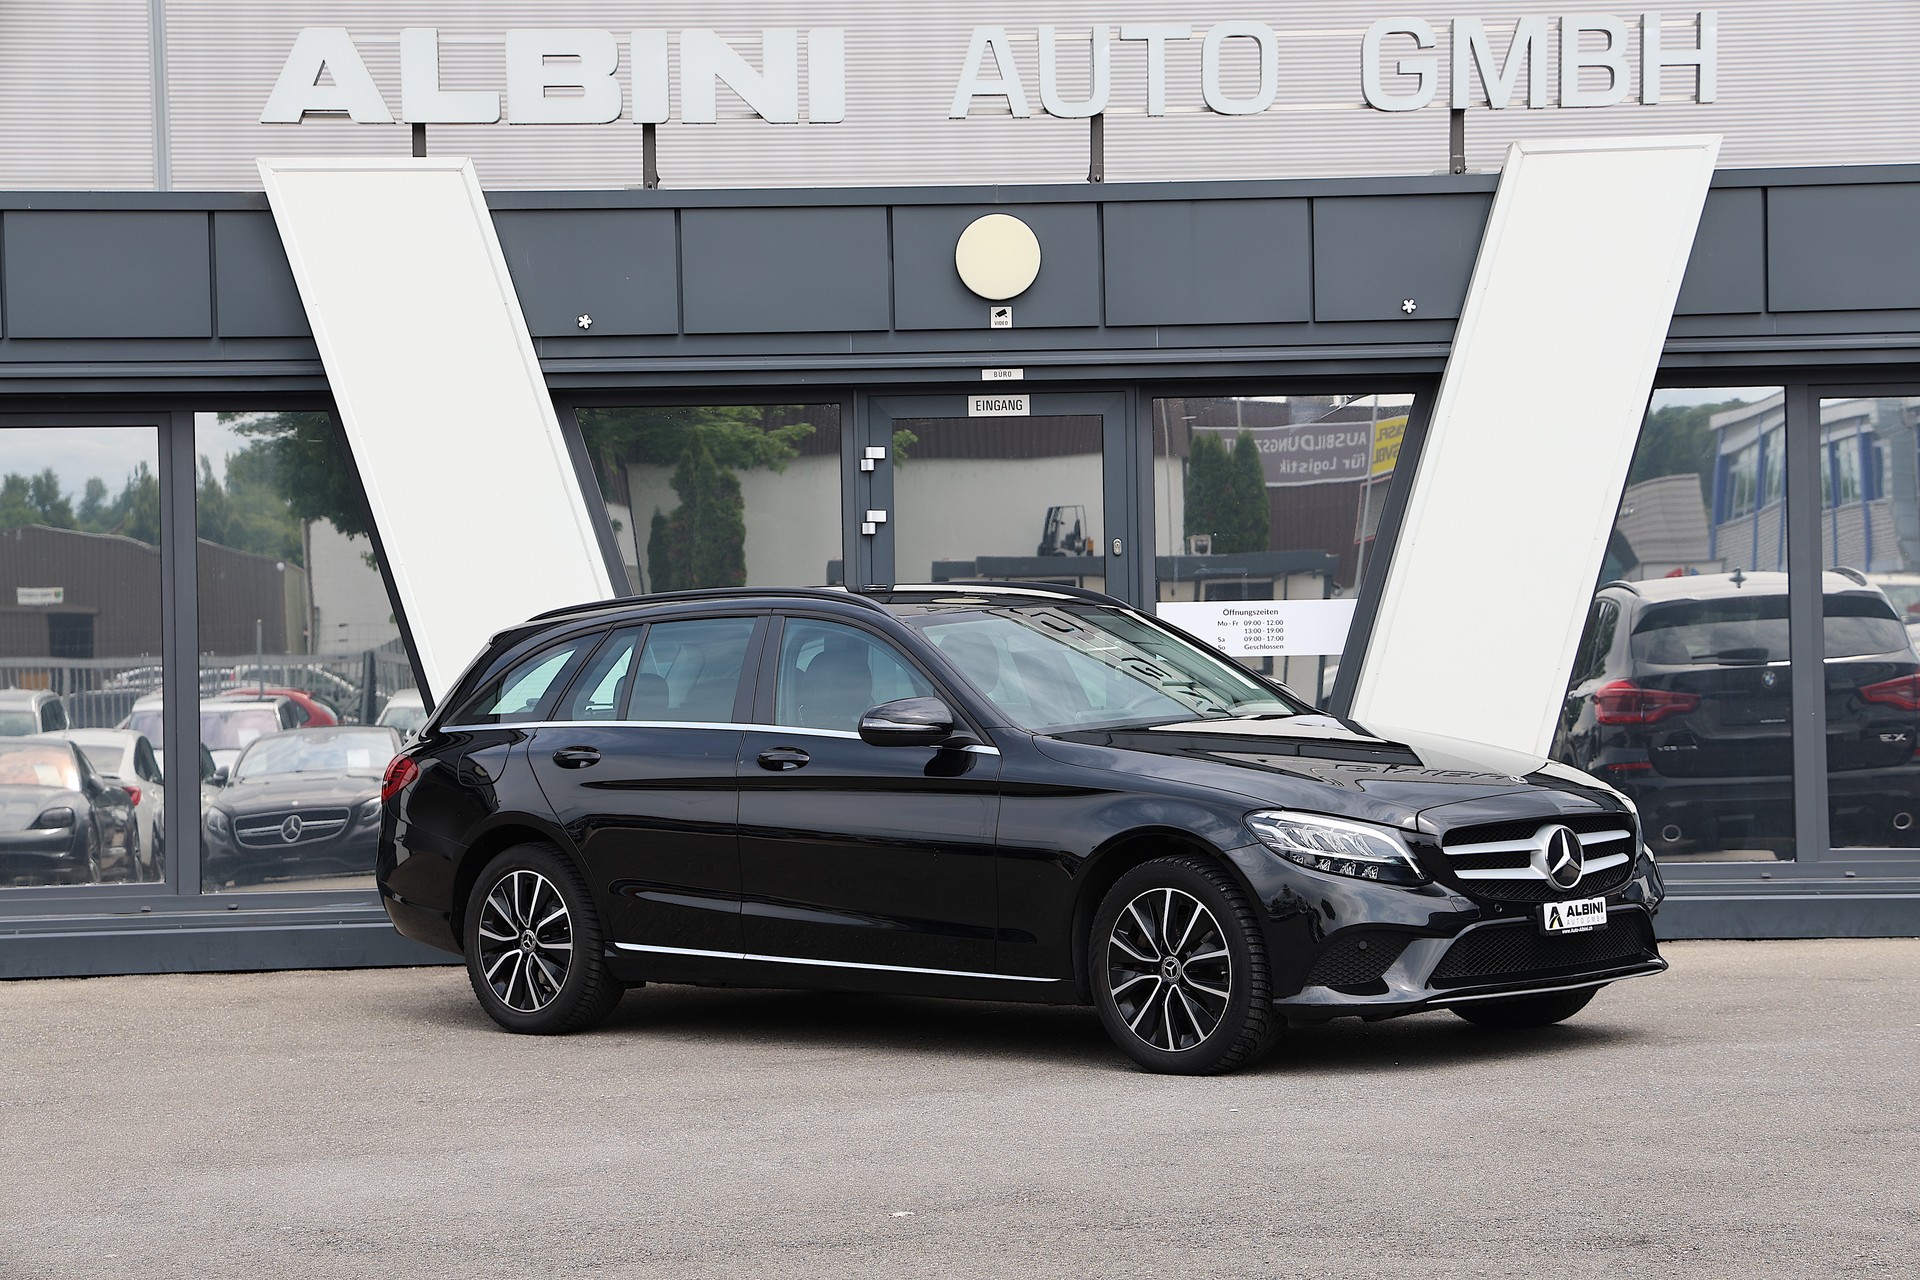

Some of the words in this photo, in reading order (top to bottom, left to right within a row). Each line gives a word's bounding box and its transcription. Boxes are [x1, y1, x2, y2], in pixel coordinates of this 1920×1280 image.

[259, 27, 845, 125] ALBINI
[948, 21, 1279, 120] AUTO
[1360, 10, 1719, 113] GMBH
[993, 369, 1012, 378] BÜRO
[975, 399, 1023, 412] EINGANG
[1222, 608, 1278, 616] Öffnungszeiten
[1567, 902, 1603, 917] ALBINI
[1587, 916, 1604, 924] GMBH
